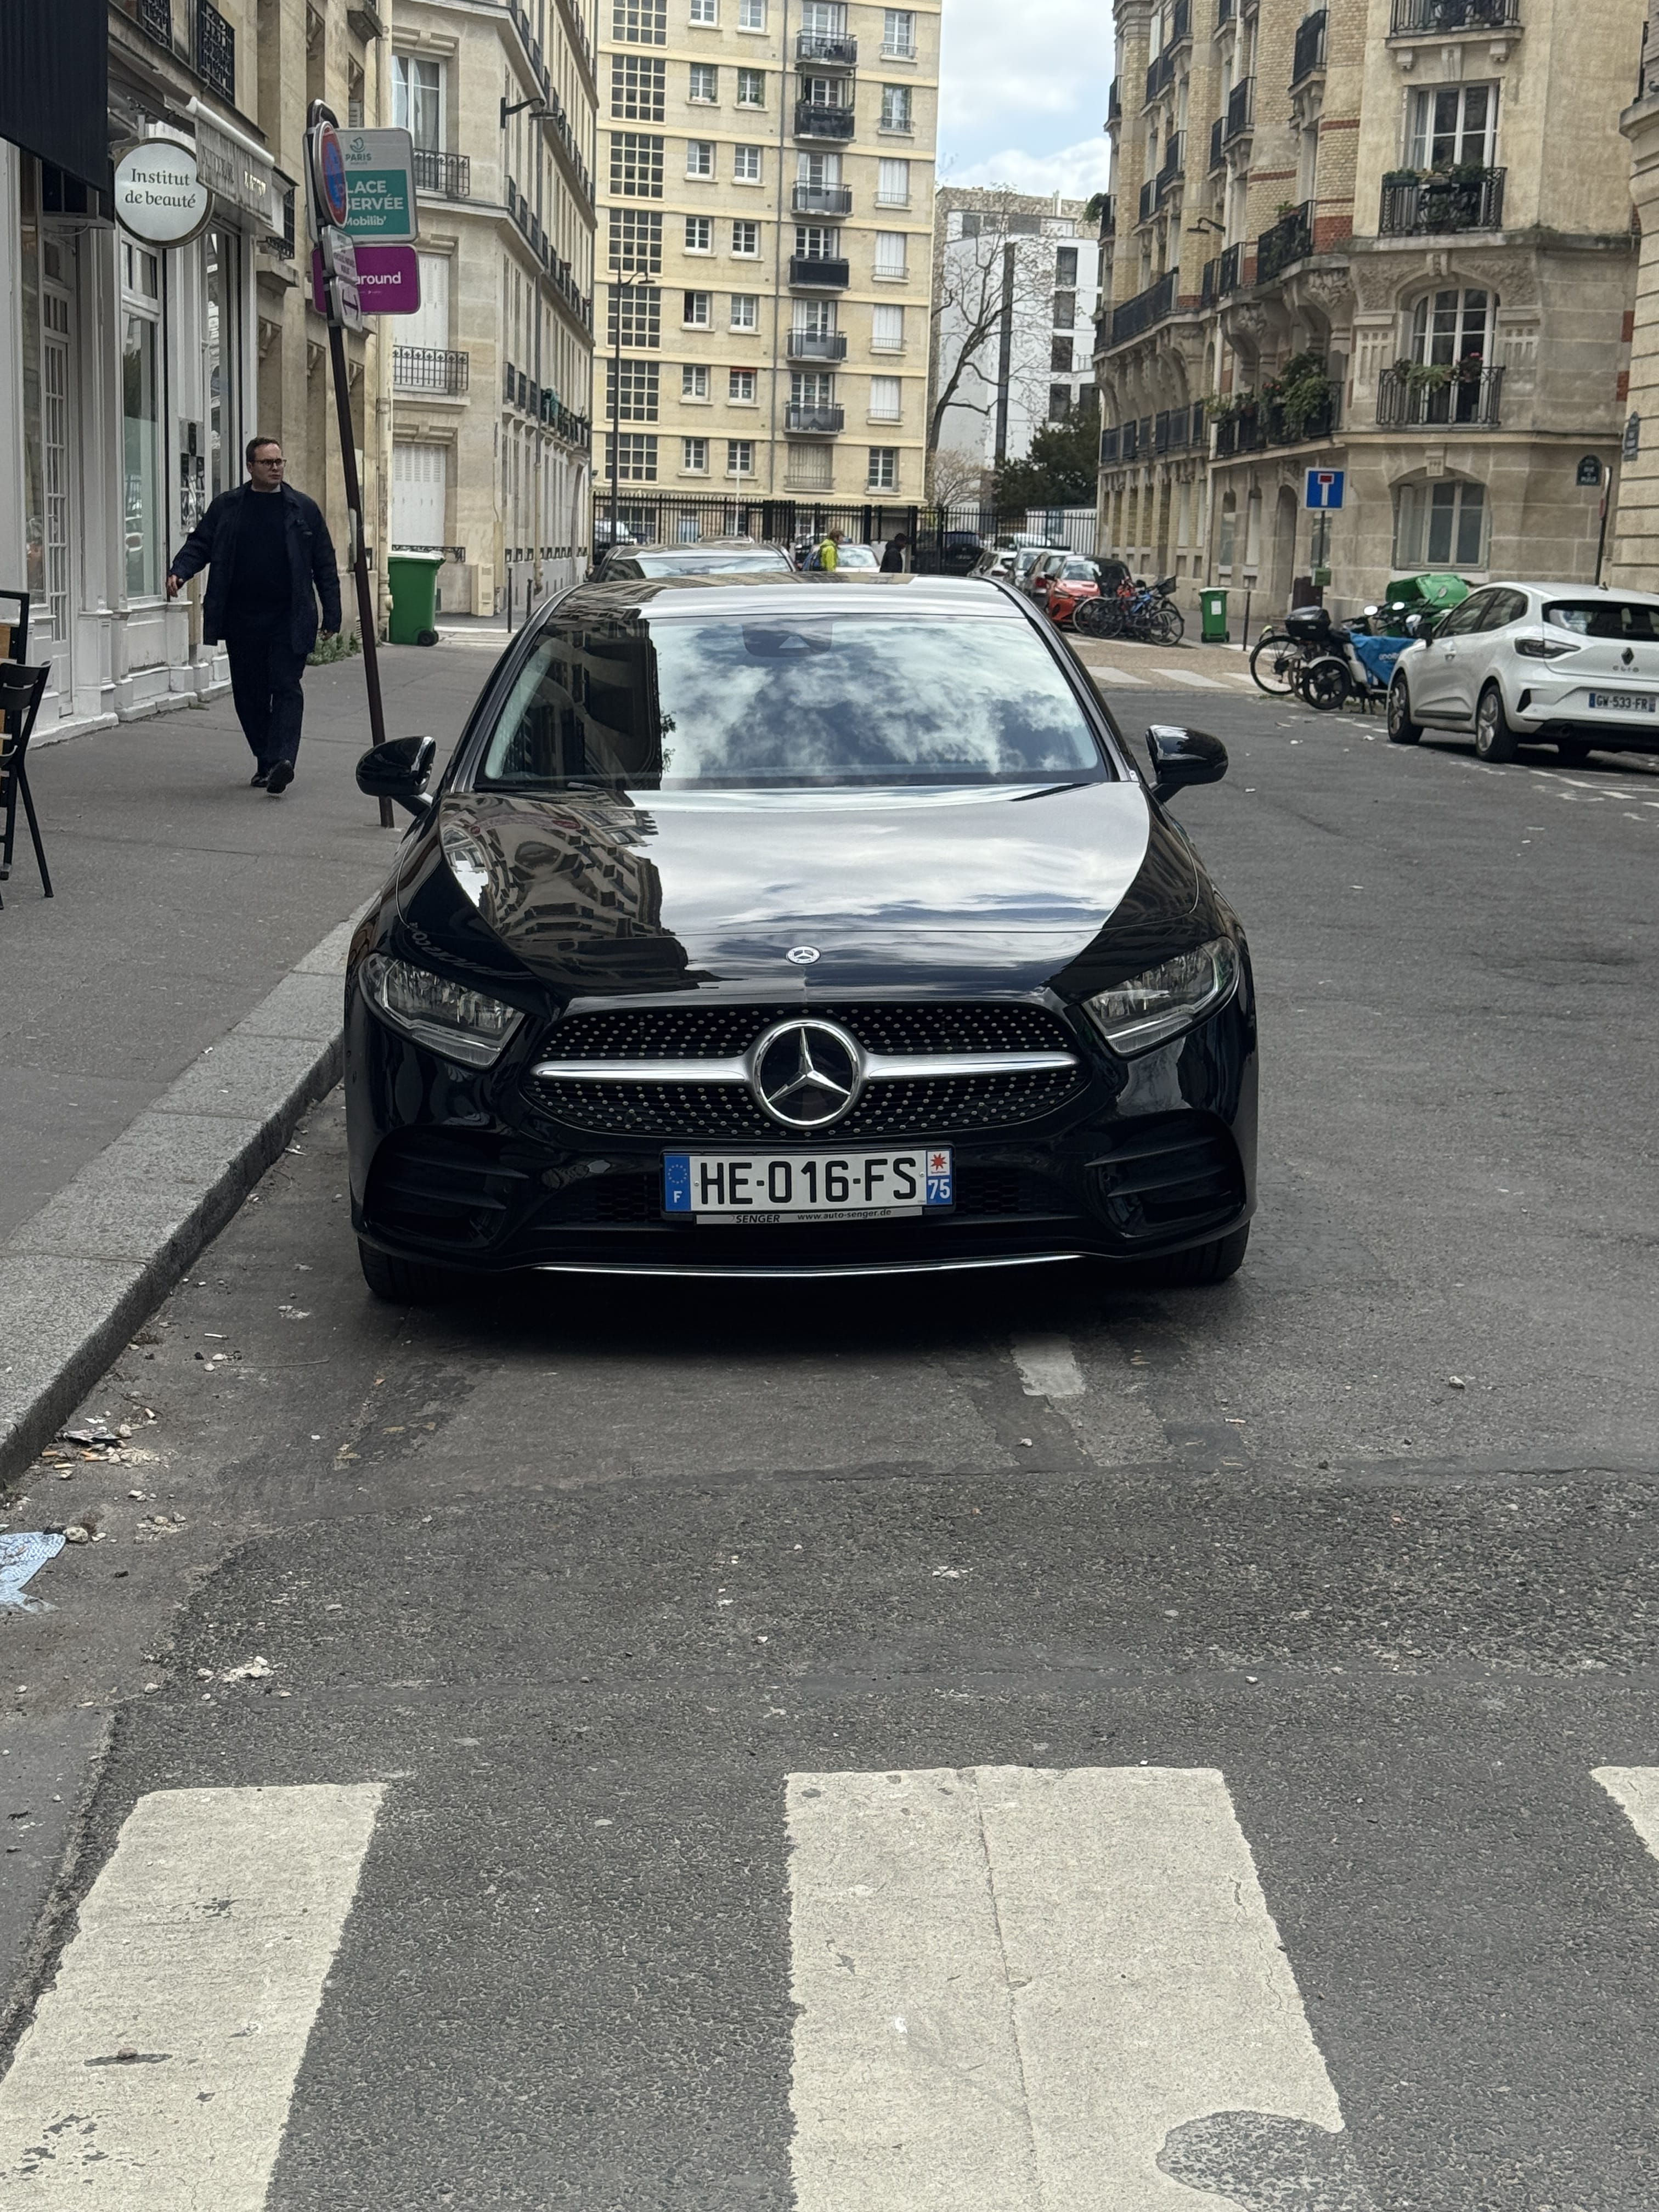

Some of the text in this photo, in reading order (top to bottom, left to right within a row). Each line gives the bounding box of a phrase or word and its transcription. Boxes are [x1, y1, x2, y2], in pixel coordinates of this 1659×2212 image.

[131, 168, 190, 186] Institut
[347, 180, 387, 193] LACE
[125, 190, 196, 208] de beauté
[348, 194, 404, 210] ERVÉE
[355, 271, 402, 285] around
[1596, 695, 1647, 709] GW-533-FR
[701, 1157, 916, 1205] HE-016-FS
[674, 1190, 682, 1203] F
[928, 1178, 950, 1200] 75
[736, 1209, 891, 1223] SENGER www.auto-senger.de
